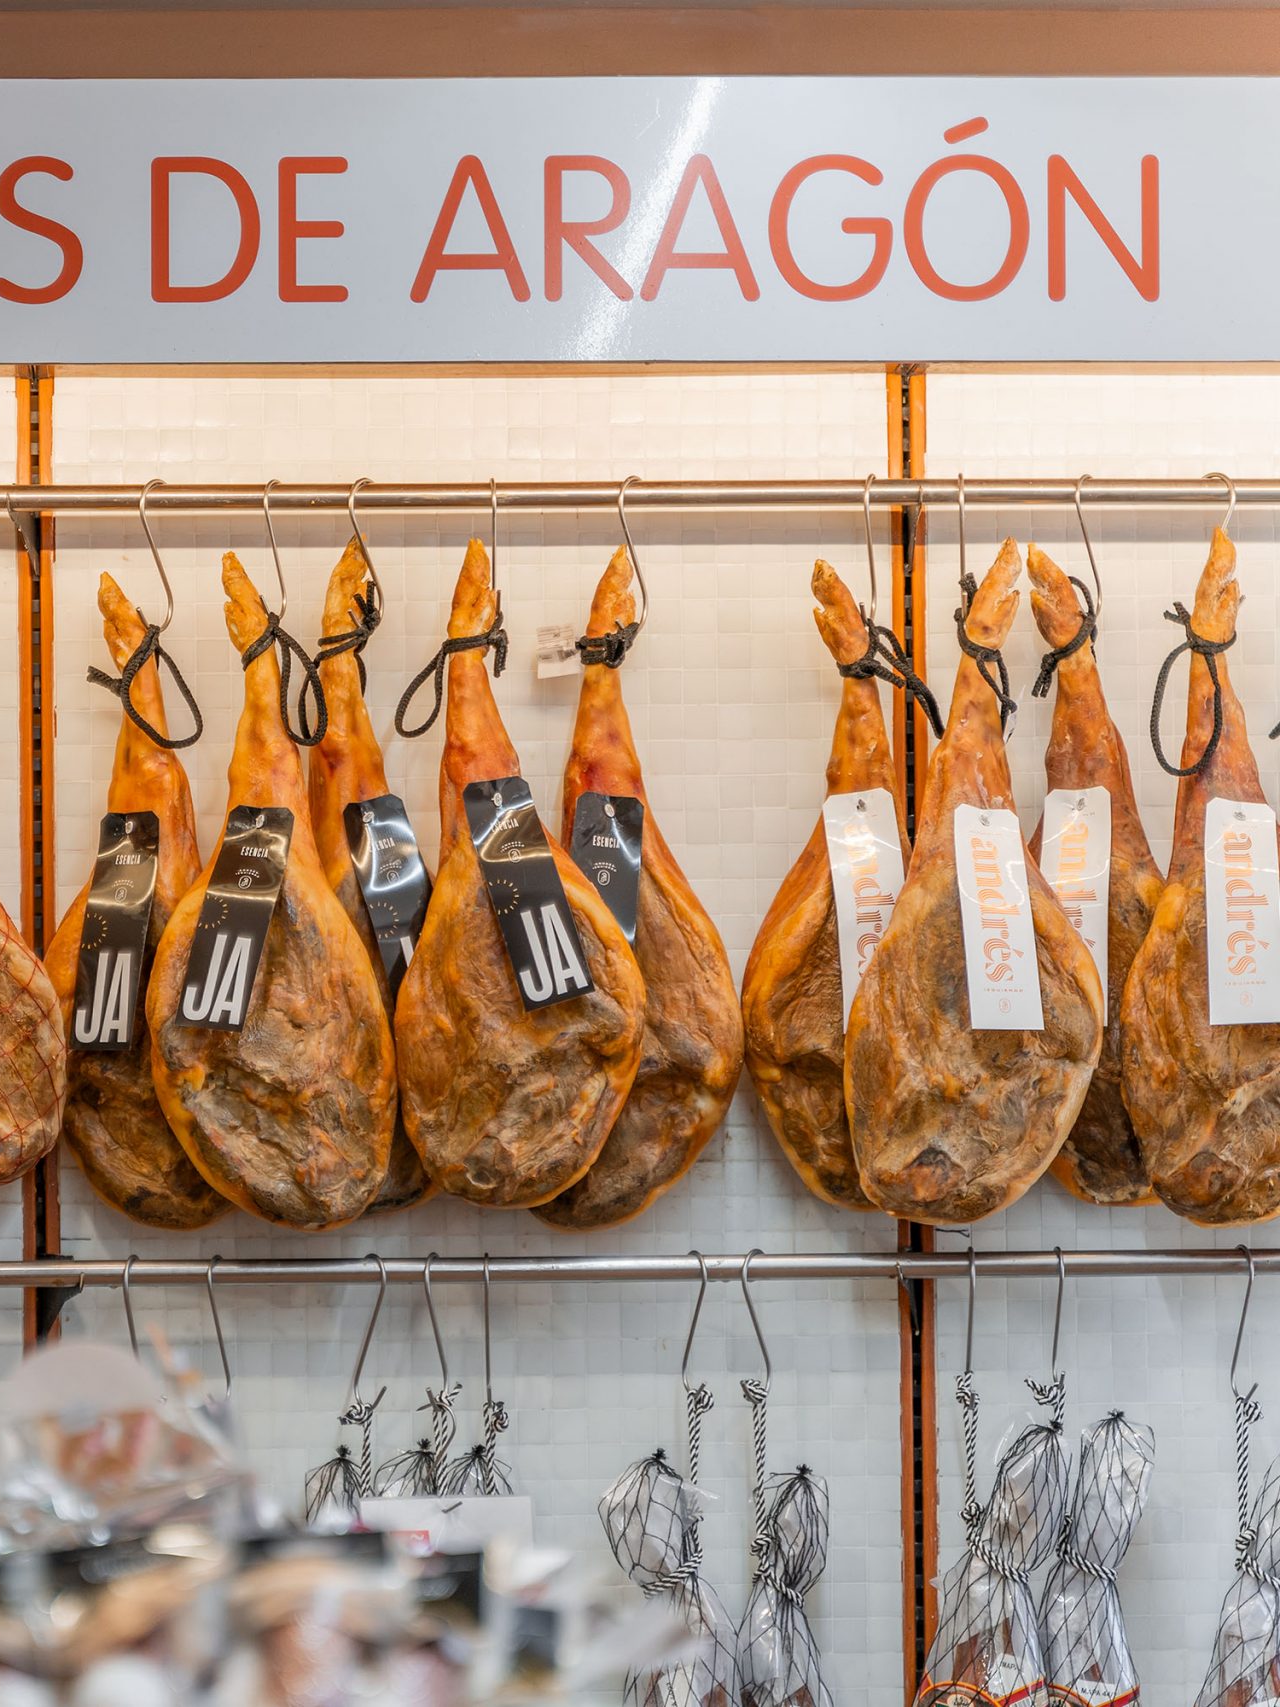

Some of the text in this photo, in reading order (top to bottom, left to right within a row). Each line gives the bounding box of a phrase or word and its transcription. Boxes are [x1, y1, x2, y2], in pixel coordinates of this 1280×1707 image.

[151, 156, 349, 303] DE
[410, 116, 1160, 303] ARAGÓN
[115, 854, 141, 865] ESENCIA
[240, 846, 269, 858] ESENCIA
[969, 837, 1025, 984] andrés
[1223, 830, 1270, 978] andrés
[75, 952, 131, 1044] JA
[183, 934, 252, 1026] JA
[520, 904, 589, 1003] JA
